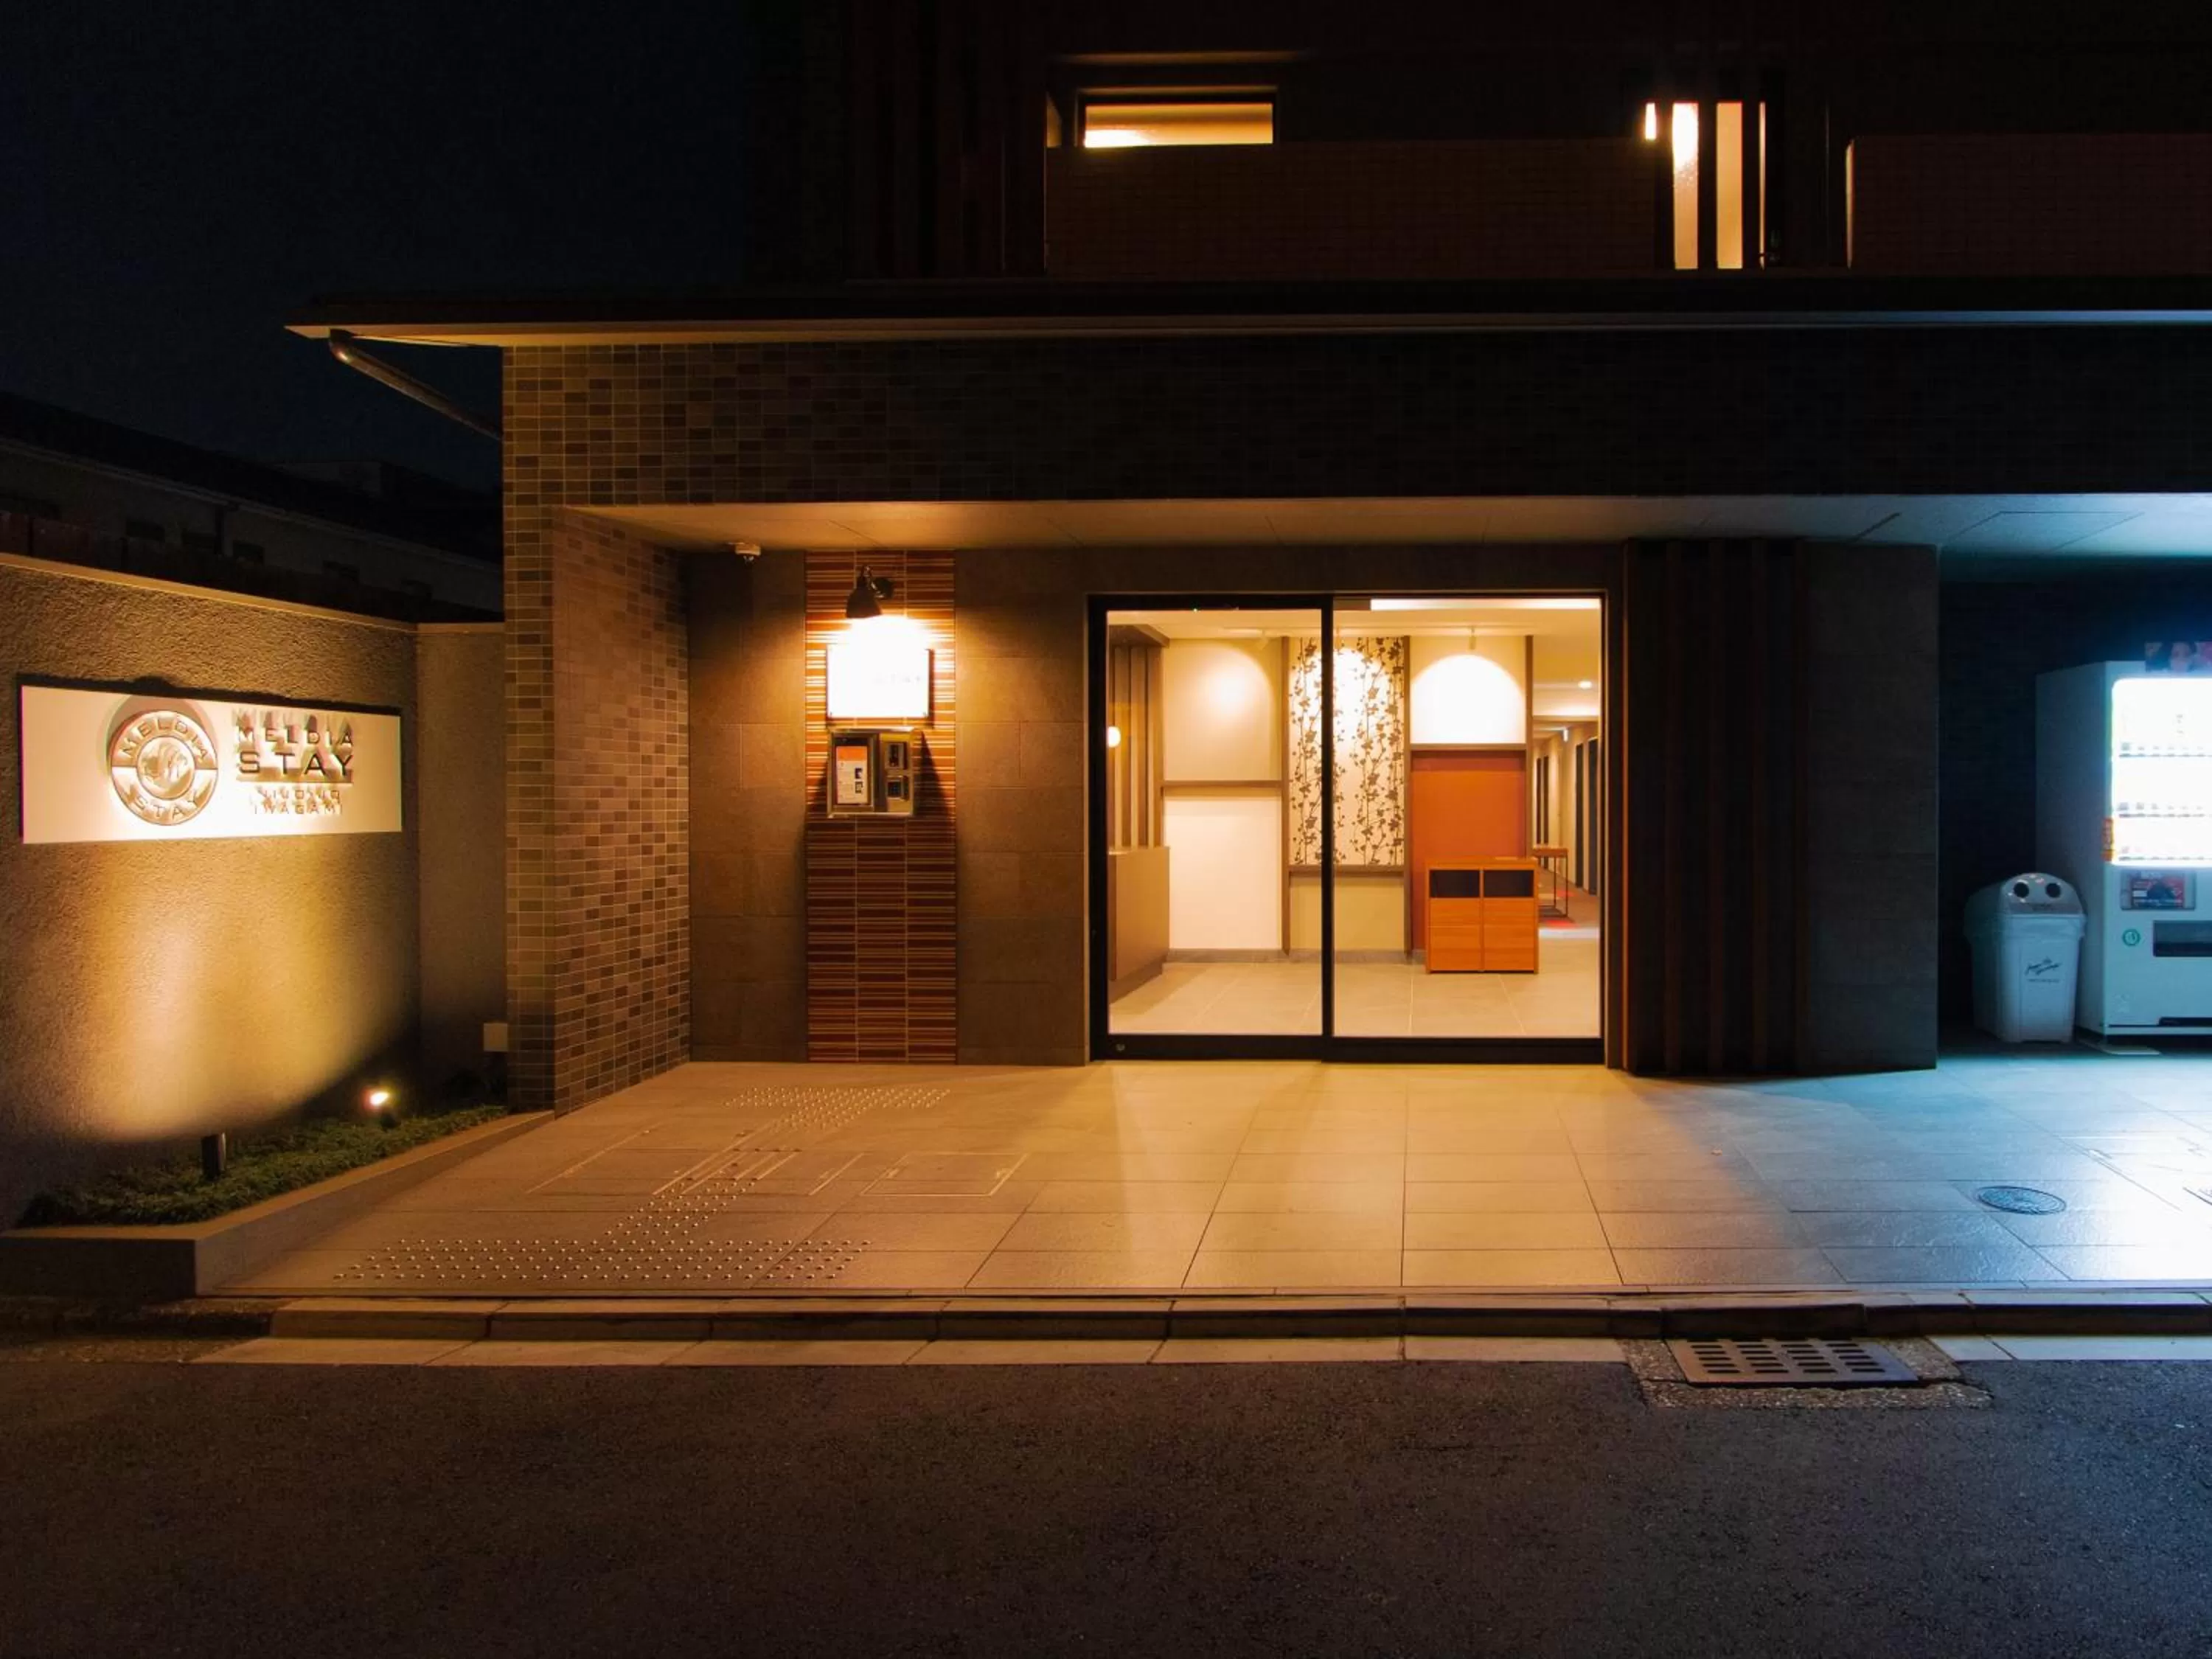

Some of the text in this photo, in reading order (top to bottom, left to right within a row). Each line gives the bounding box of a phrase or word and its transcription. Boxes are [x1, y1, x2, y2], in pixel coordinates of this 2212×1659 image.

[120, 717, 209, 761] MELDIA
[238, 728, 353, 745] MELDIA
[240, 750, 354, 775] STAY
[133, 788, 198, 820] STAY
